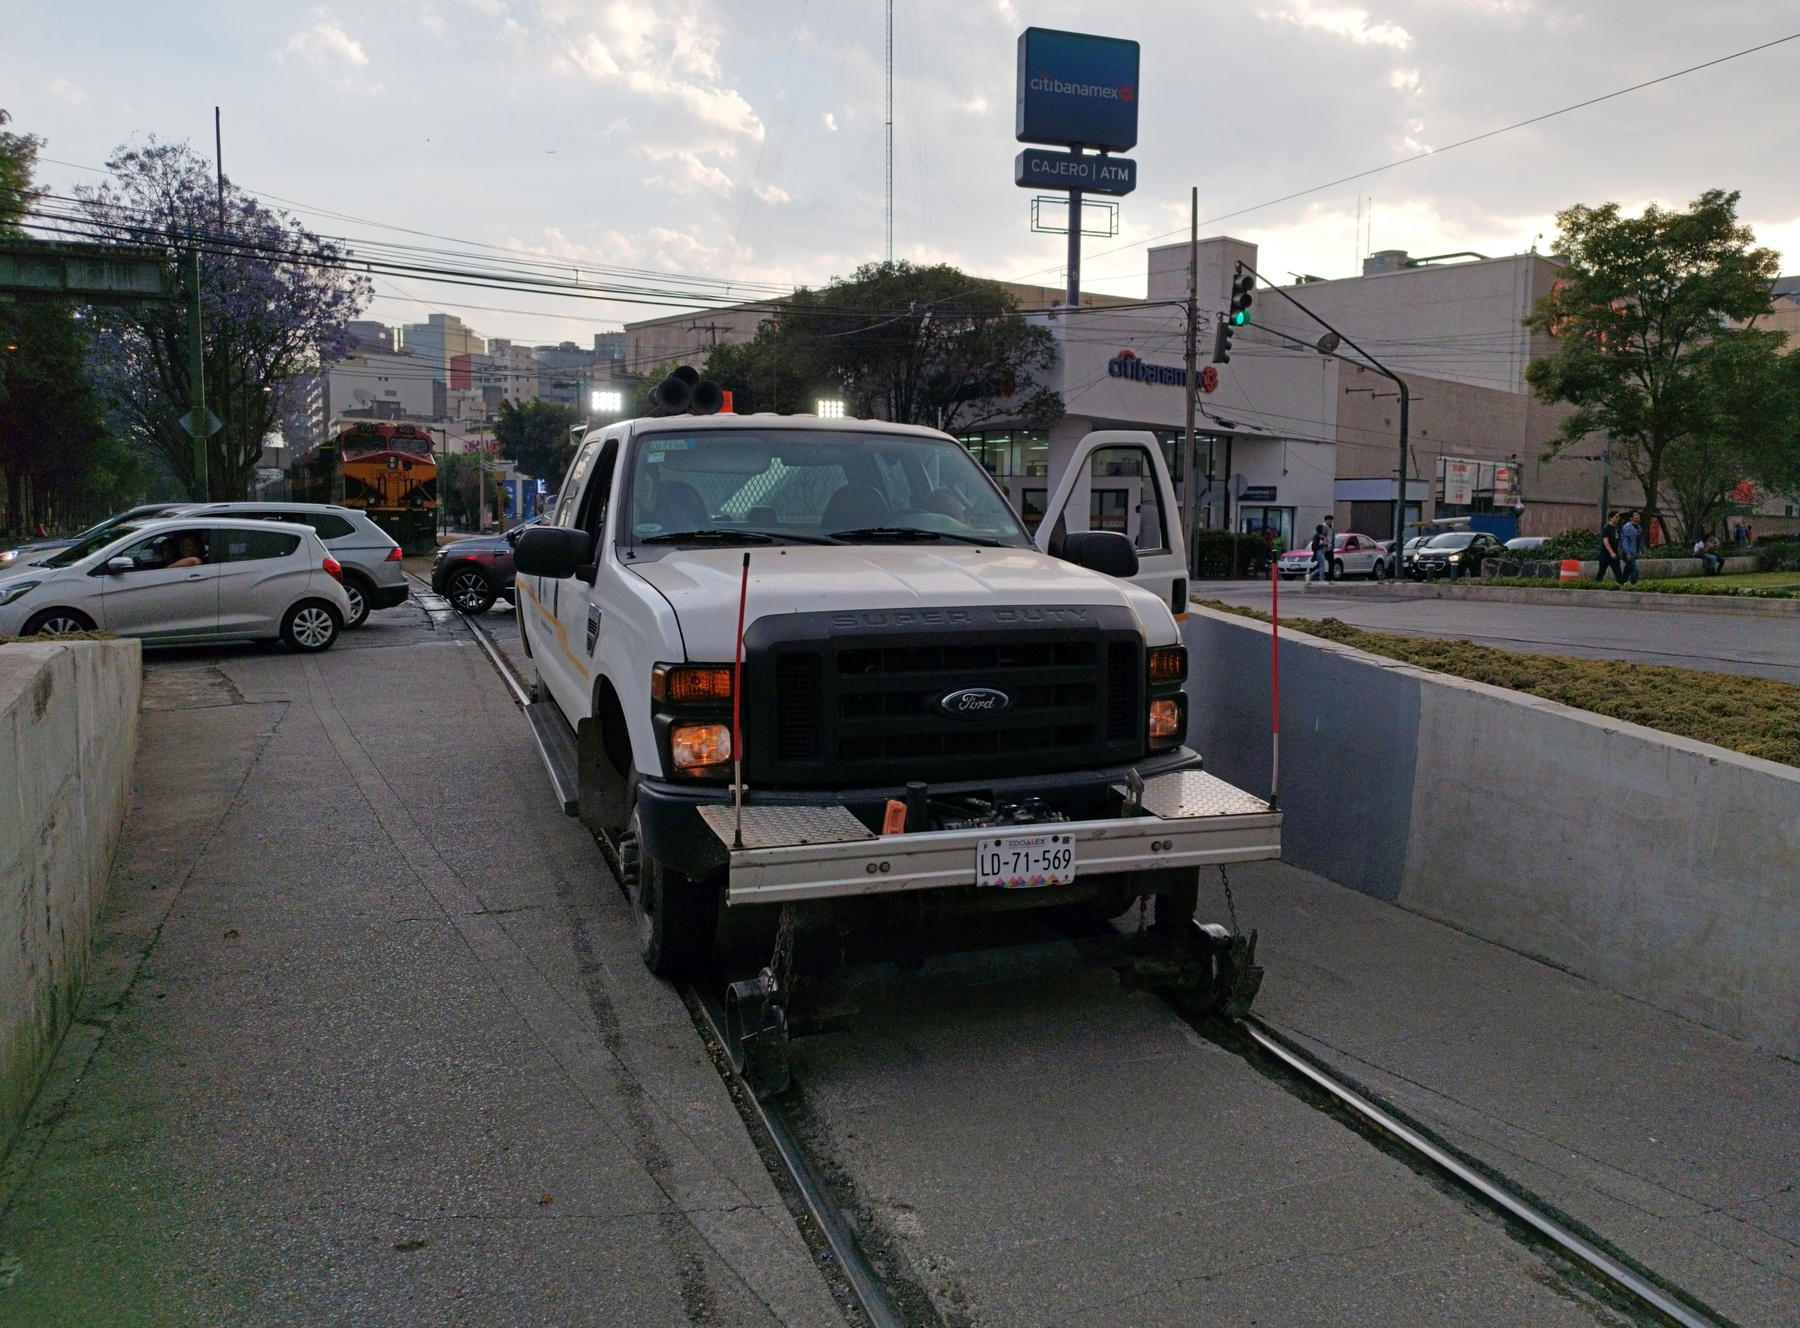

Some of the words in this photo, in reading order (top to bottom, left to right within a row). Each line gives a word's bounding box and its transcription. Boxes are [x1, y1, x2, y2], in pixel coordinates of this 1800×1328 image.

[1030, 77, 1118, 99] citibanamex
[1031, 159, 1088, 176] CAJERO
[1100, 166, 1128, 181] ATM
[1108, 356, 1204, 389] citibanamx
[831, 609, 972, 629] SUPER
[993, 607, 1087, 623] DUTY
[958, 693, 994, 711] Ford
[981, 848, 1071, 876] LD-71-569
